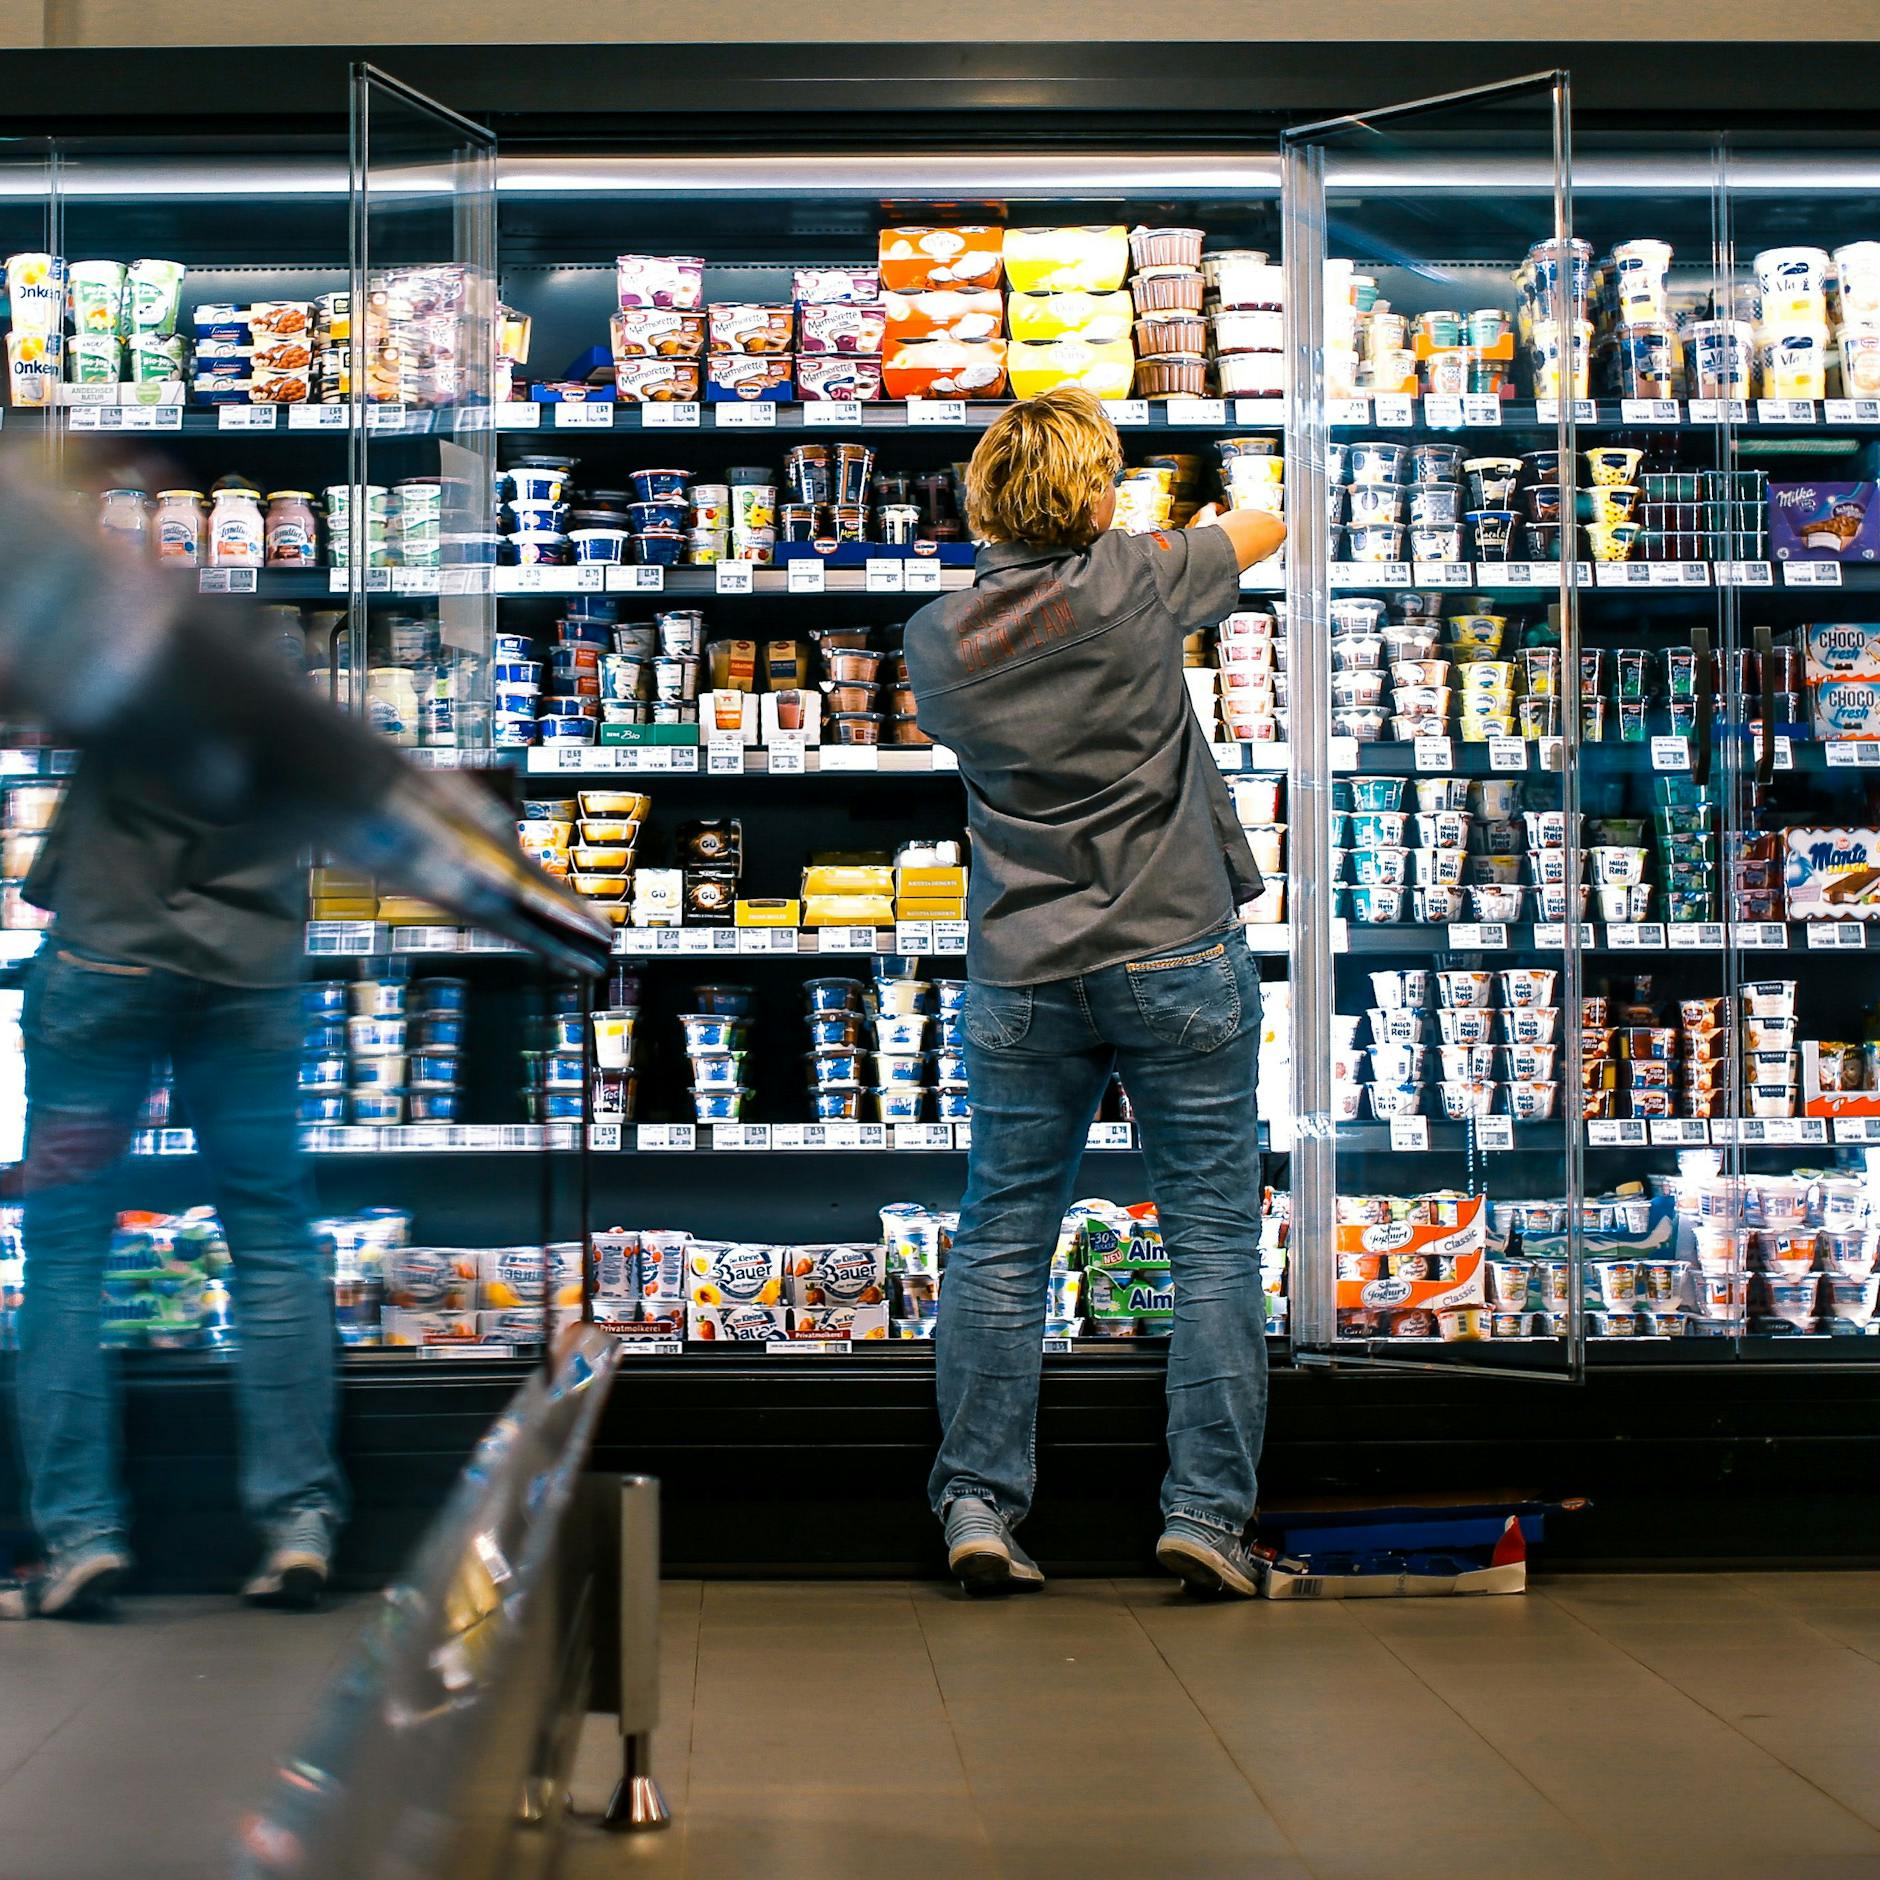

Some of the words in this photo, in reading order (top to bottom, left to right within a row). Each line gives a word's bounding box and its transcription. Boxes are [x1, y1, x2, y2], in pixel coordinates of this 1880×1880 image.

[808, 310, 858, 330] Marmorette
[14, 361, 59, 375] Onken
[714, 361, 764, 381] Marmorette
[802, 363, 853, 382] Marmorette
[621, 366, 671, 386] Marmorette
[1776, 488, 1816, 508] Milka
[1819, 632, 1865, 648] CHOCO
[1825, 646, 1861, 662] fresh
[1828, 690, 1874, 707] CHOCO
[1834, 705, 1870, 721] fresh
[620, 730, 641, 740] Bio
[1440, 832, 1459, 840] Reis
[1544, 832, 1562, 840] Reis
[1809, 843, 1867, 871] Monte
[1609, 867, 1628, 876] Reis
[1827, 863, 1870, 874] SNACK
[1428, 904, 1448, 913] Reis
[1547, 904, 1564, 912] Reis
[1455, 992, 1472, 1000] Reis
[1391, 1028, 1411, 1036] Reis
[1460, 1028, 1478, 1036] Reis
[1518, 1027, 1538, 1036] Reis
[1517, 1064, 1535, 1073] Reis
[1444, 1228, 1478, 1251] Classic
[738, 1252, 760, 1262] Kleine
[1128, 1240, 1170, 1262] Alm
[842, 1254, 864, 1263] Kleine
[1103, 1252, 1122, 1265] NEU
[719, 1264, 773, 1281] Bauer
[822, 1264, 877, 1282] Bauer
[1378, 1282, 1401, 1290] Sahne
[1368, 1286, 1408, 1301] Joghurt
[1442, 1285, 1476, 1306] Classic
[741, 1313, 764, 1323] Kleine
[600, 1324, 661, 1333] Privatmolkerei
